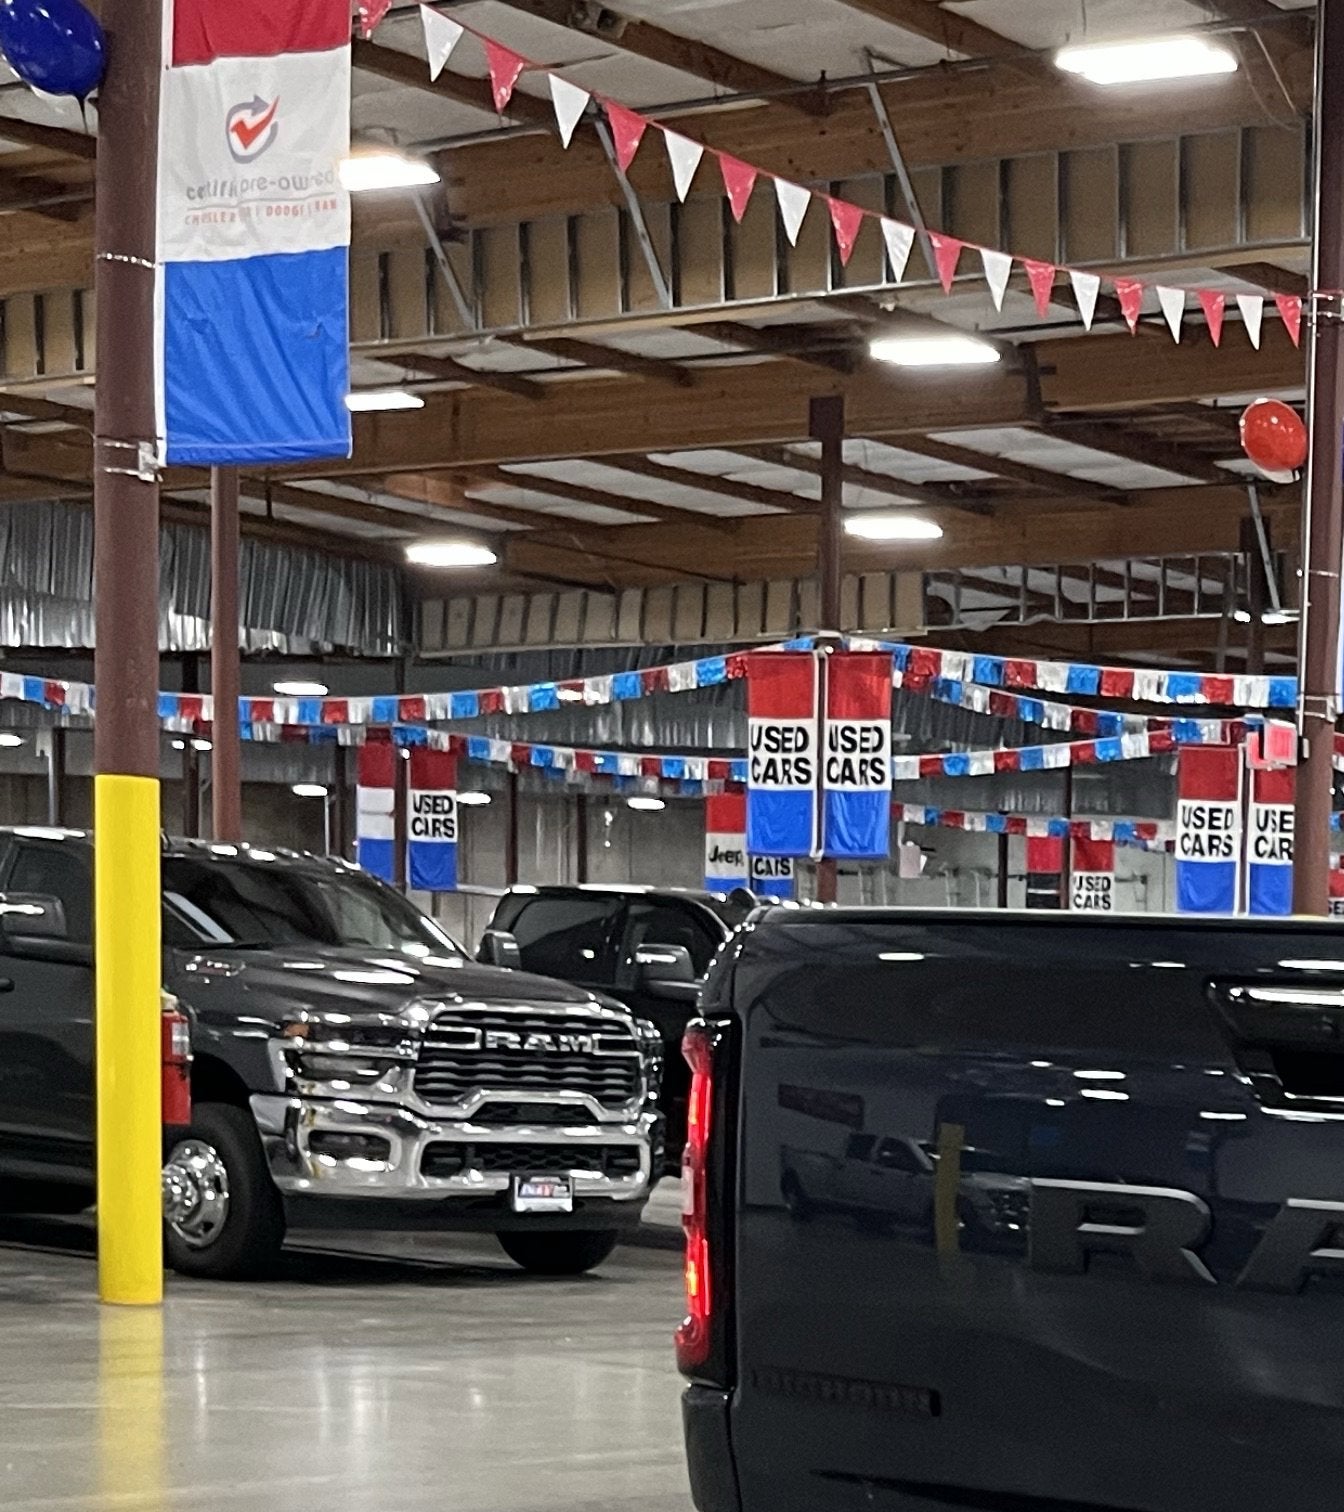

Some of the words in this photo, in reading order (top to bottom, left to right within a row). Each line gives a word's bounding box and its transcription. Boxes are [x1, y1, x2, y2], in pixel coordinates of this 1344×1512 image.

[751, 724, 809, 753] USED
[829, 725, 885, 753] USED
[751, 756, 812, 785] CARS
[826, 756, 886, 785] CARS
[413, 794, 454, 815] USED
[1182, 806, 1234, 831] USED
[1256, 807, 1293, 833] USE
[1180, 832, 1233, 857] CARS
[1255, 835, 1293, 860] CAR
[485, 1030, 593, 1053] RAM
